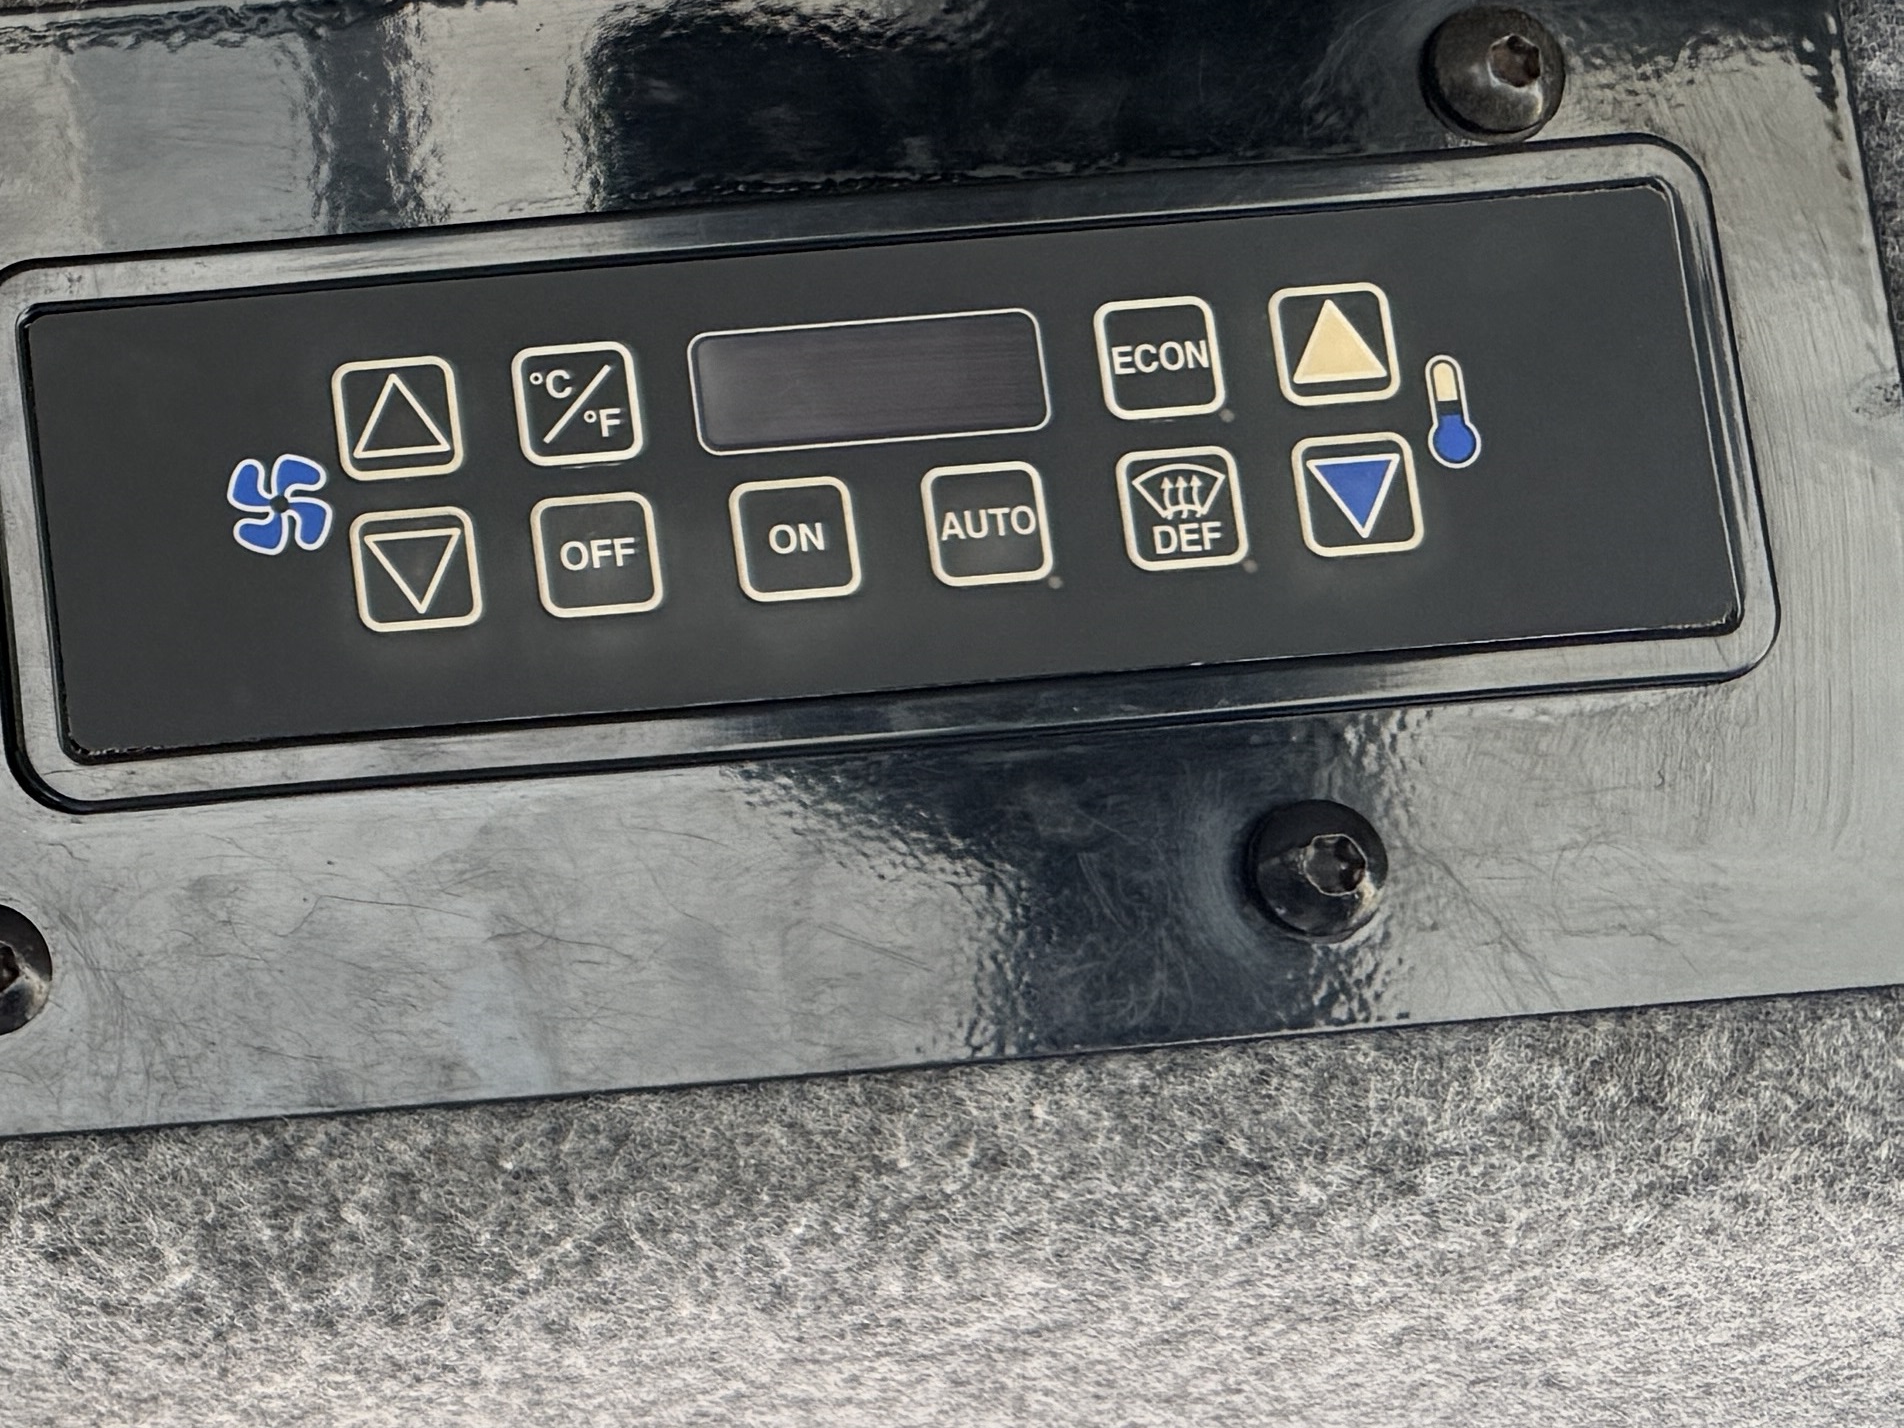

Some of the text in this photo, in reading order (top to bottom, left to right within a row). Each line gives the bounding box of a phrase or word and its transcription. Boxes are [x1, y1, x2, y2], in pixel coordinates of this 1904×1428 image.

[1111, 339, 1210, 376] ECON
[767, 521, 825, 556] ON
[940, 504, 1036, 543] AUTO
[1152, 520, 1223, 556] DEF
[559, 536, 636, 572] OFF
